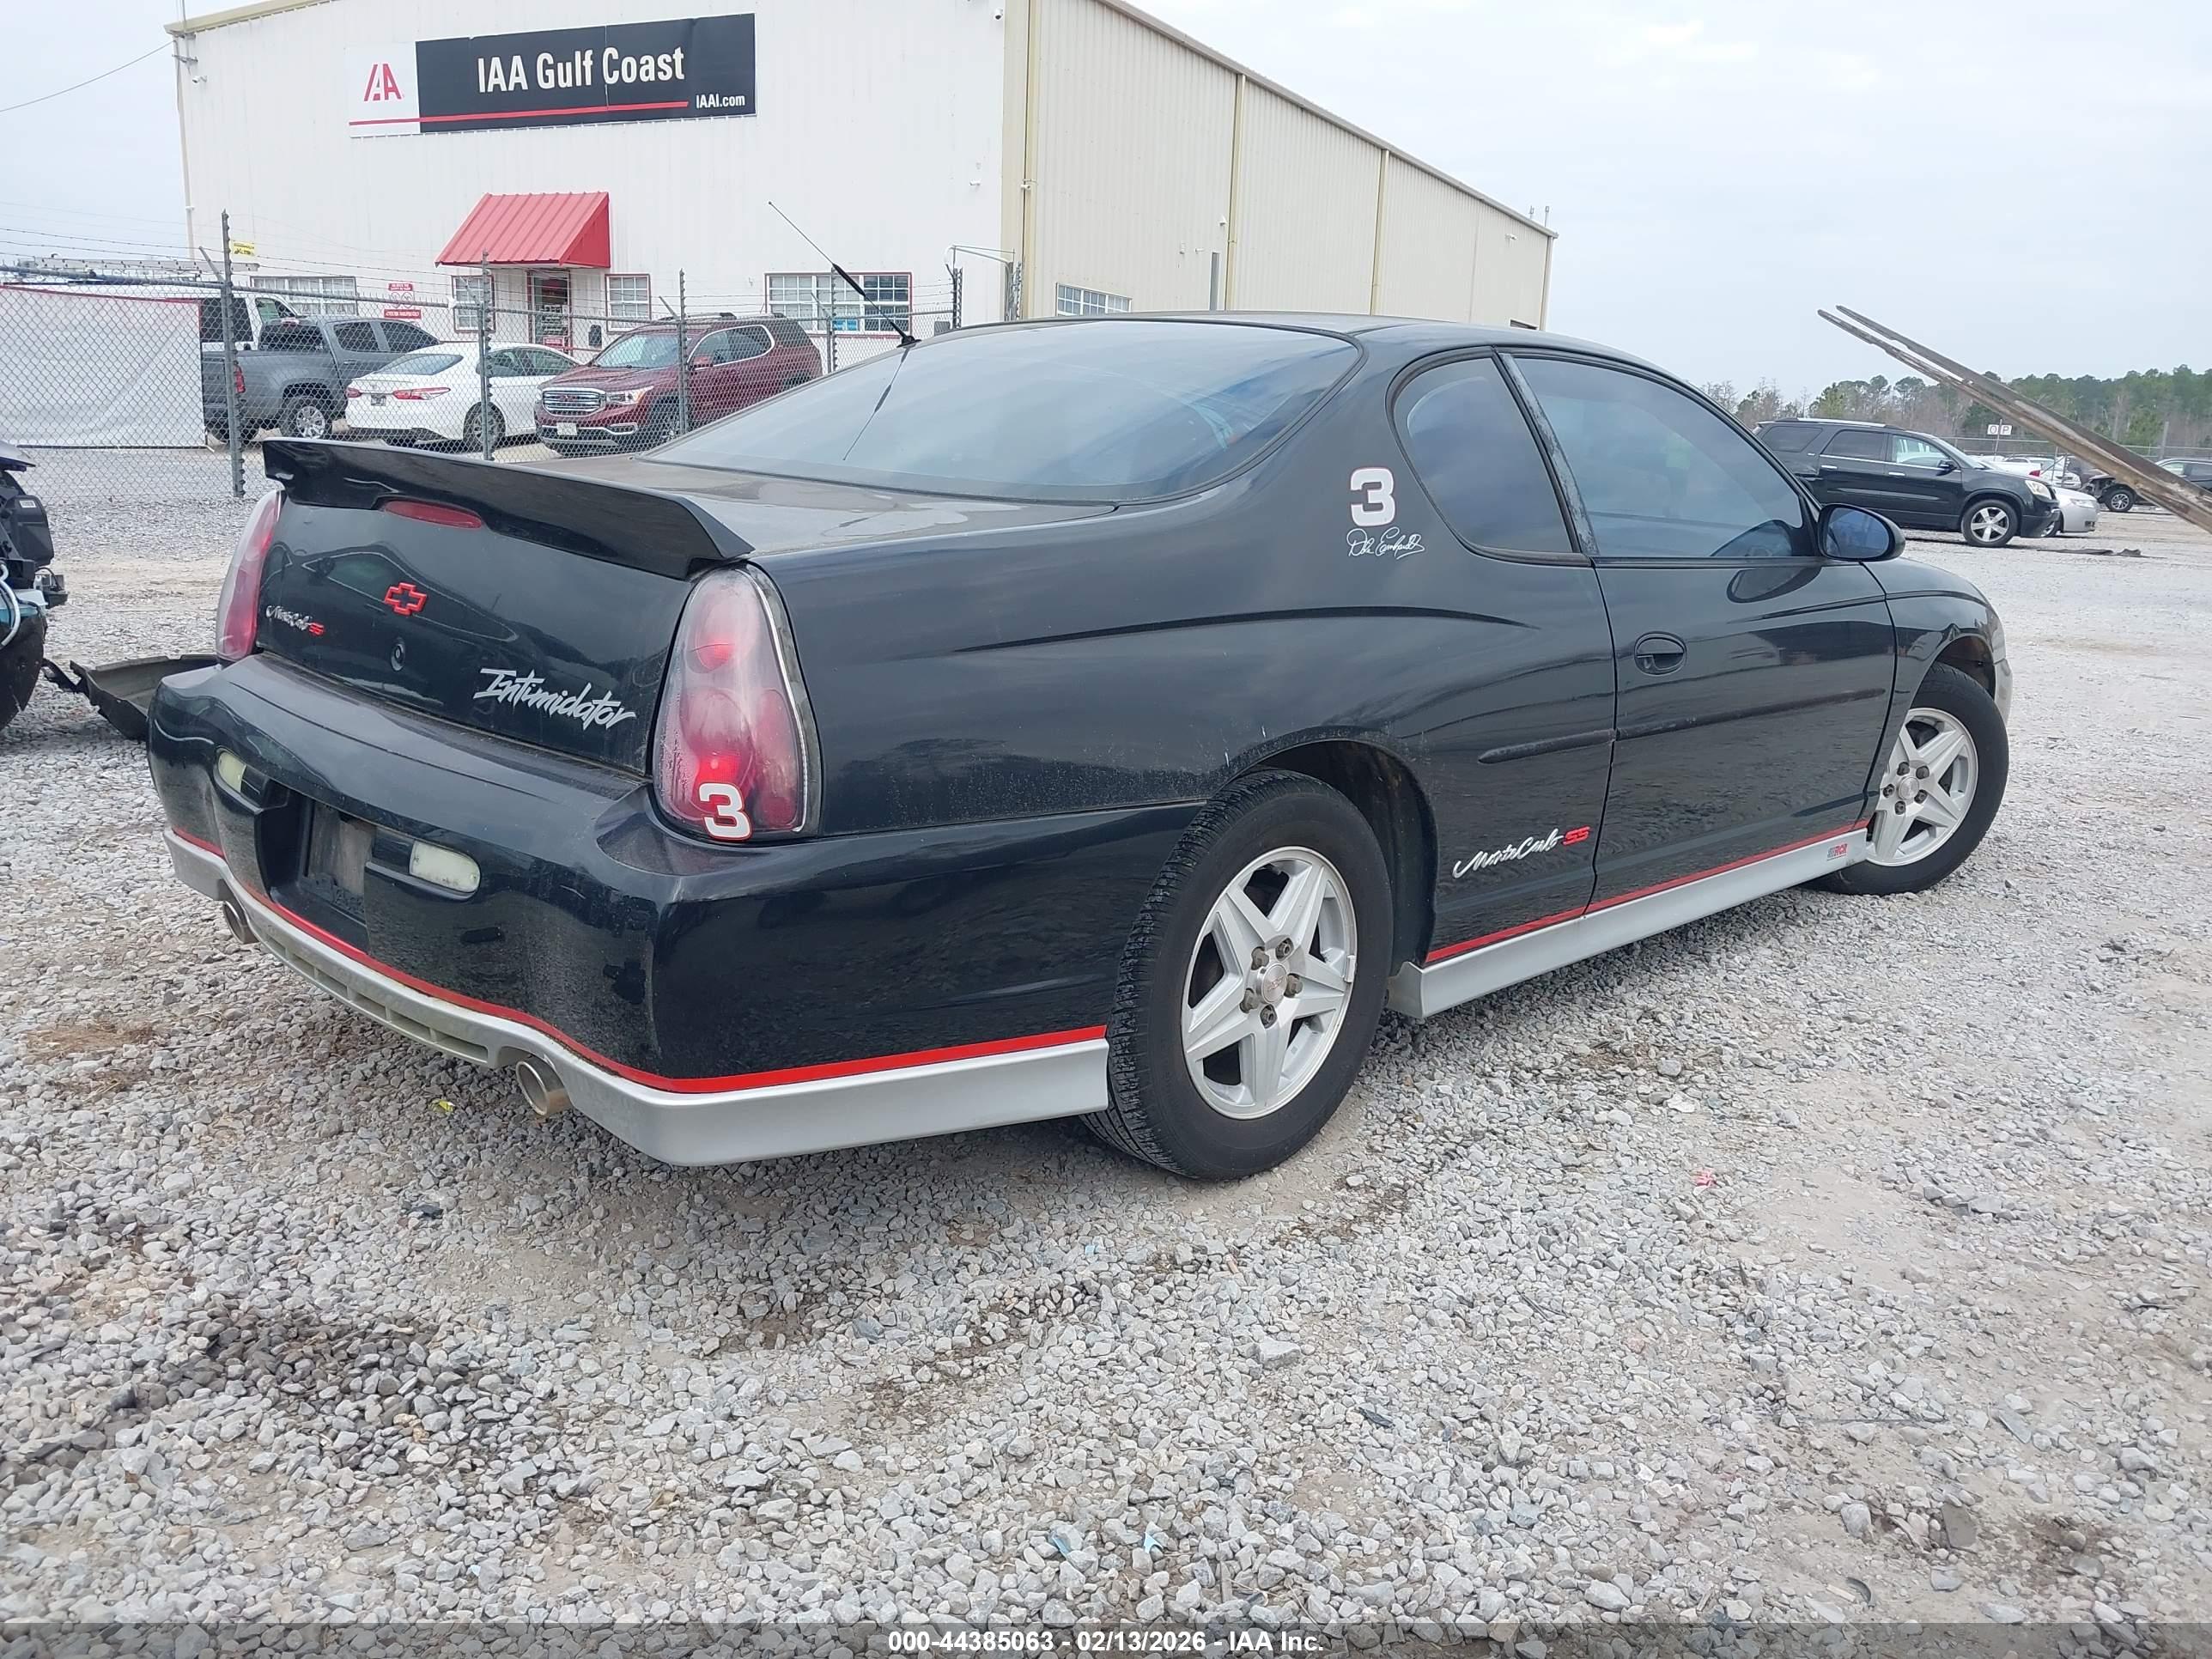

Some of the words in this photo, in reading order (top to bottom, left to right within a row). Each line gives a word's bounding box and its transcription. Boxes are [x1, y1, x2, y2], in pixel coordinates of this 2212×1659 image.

[477, 55, 528, 93] IAA
[536, 49, 593, 89] Gulf
[602, 46, 684, 84] Coast
[696, 94, 745, 109] IAAI.com
[1350, 466, 1395, 527] 3
[472, 668, 636, 731] Intimidator
[698, 782, 751, 839] 3
[1563, 826, 1591, 846] SS
